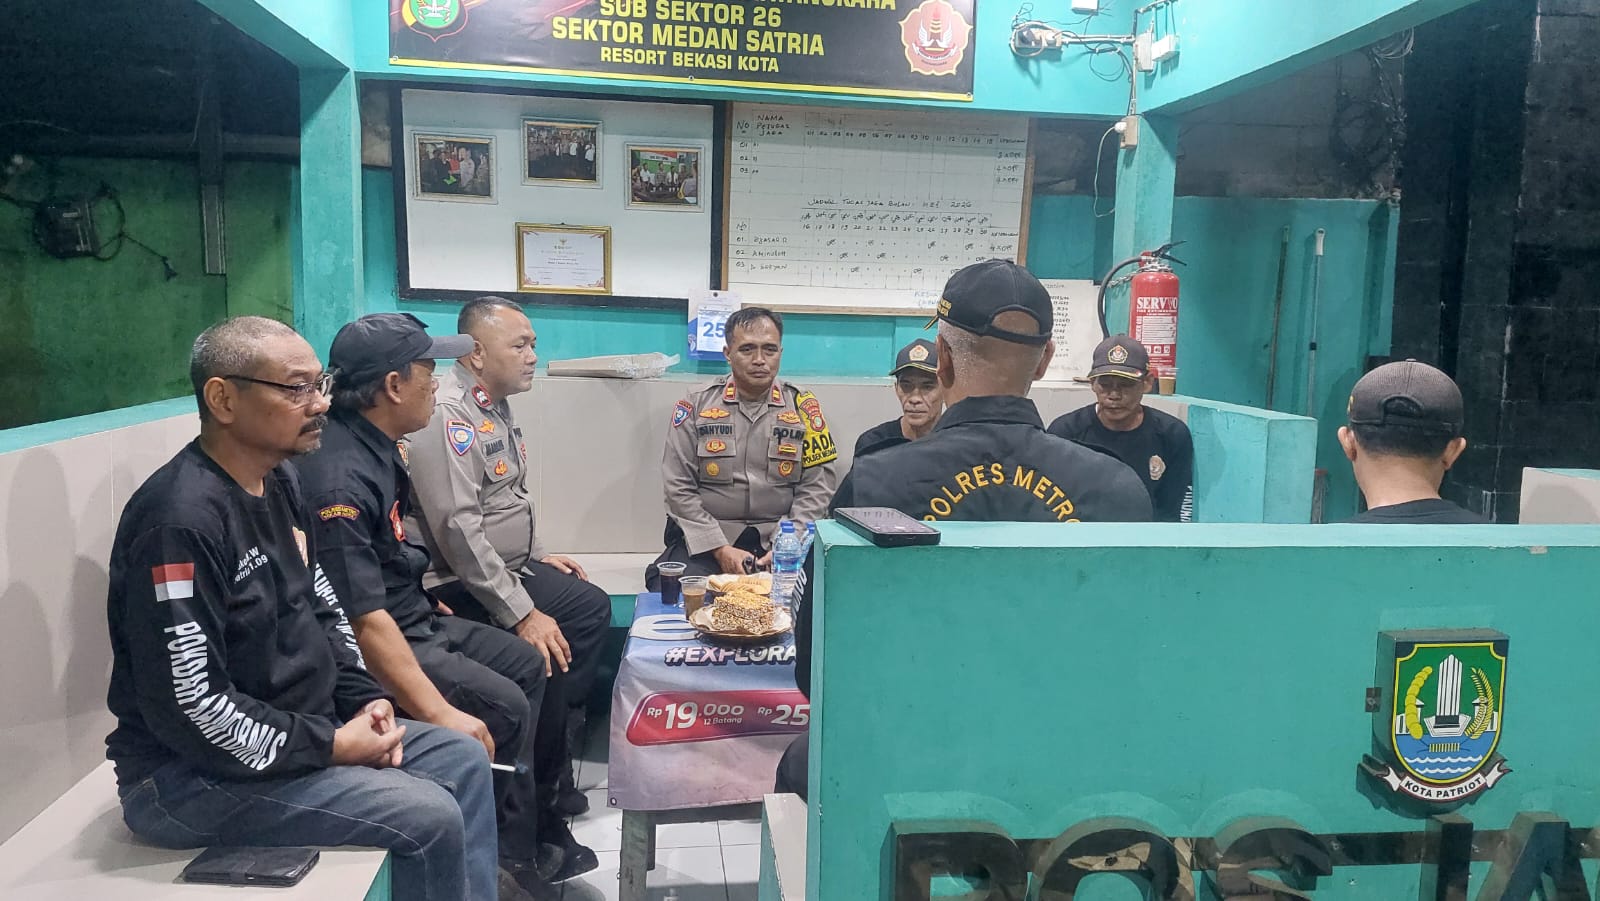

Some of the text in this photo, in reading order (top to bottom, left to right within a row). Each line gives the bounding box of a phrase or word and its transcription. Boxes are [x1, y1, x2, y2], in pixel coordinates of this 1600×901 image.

[600, 1, 647, 20] SUB
[655, 3, 745, 26] SEKTOR
[753, 7, 782, 28] 26
[552, 16, 825, 56] SEKTOR MEDAN SATRIA
[600, 47, 780, 73] RESORT BEKASI KOTA
[702, 322, 726, 338] 25
[248, 554, 268, 570] 1.09
[163, 620, 210, 706] POKDAR
[647, 706, 663, 718] Rp
[757, 706, 773, 716] Rp
[770, 704, 810, 726] 25
[703, 717, 743, 726] 12 Batang
[1404, 776, 1483, 798] KOTA PATRIOT
